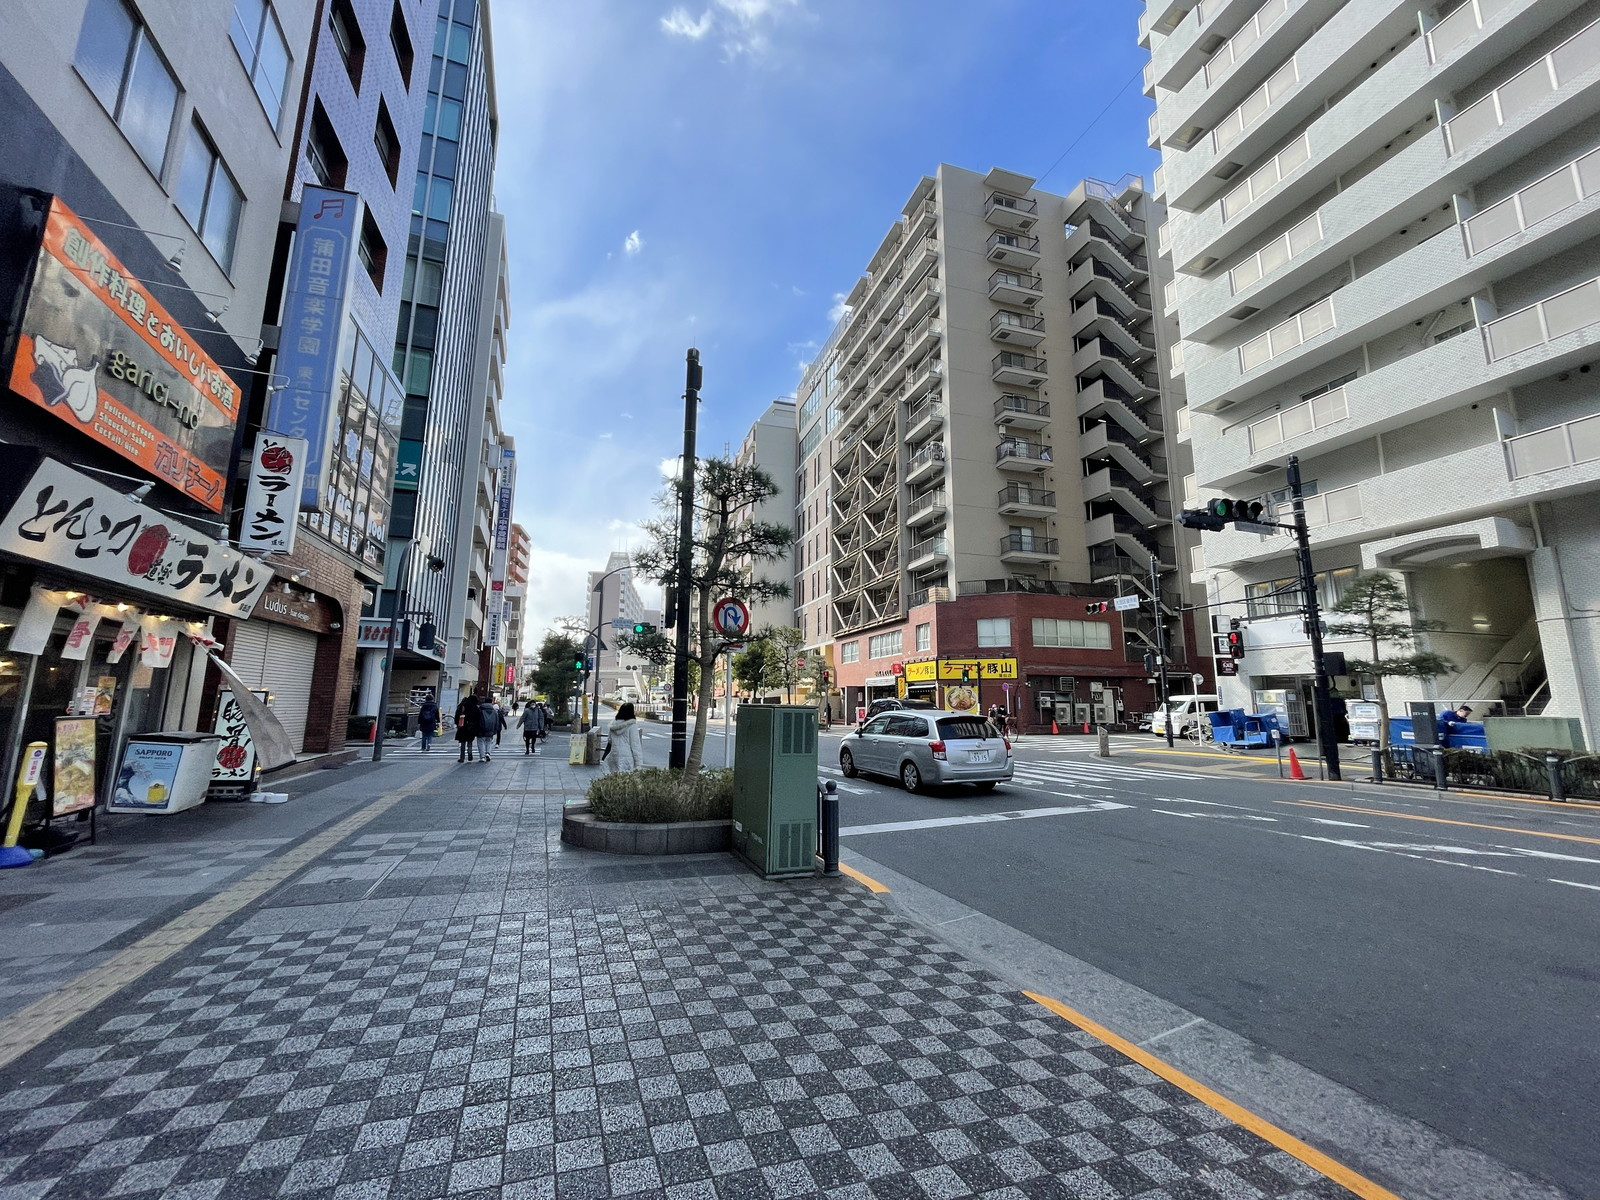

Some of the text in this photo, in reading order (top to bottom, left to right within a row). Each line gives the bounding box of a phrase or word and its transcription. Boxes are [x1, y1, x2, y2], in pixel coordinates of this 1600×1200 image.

[63, 226, 235, 412] 創作料理とおいしいお酒
[297, 237, 335, 355] 蒲田音楽学園
[103, 400, 155, 441] Delicious Foods
[153, 441, 220, 502] ガリチーノ
[17, 485, 143, 559] とんこつ
[249, 474, 291, 541] ラーメン
[169, 540, 262, 604] ラーメン
[264, 595, 289, 615] Ludus
[134, 748, 173, 757] SAPPORO
[211, 768, 249, 778] ラーメン
